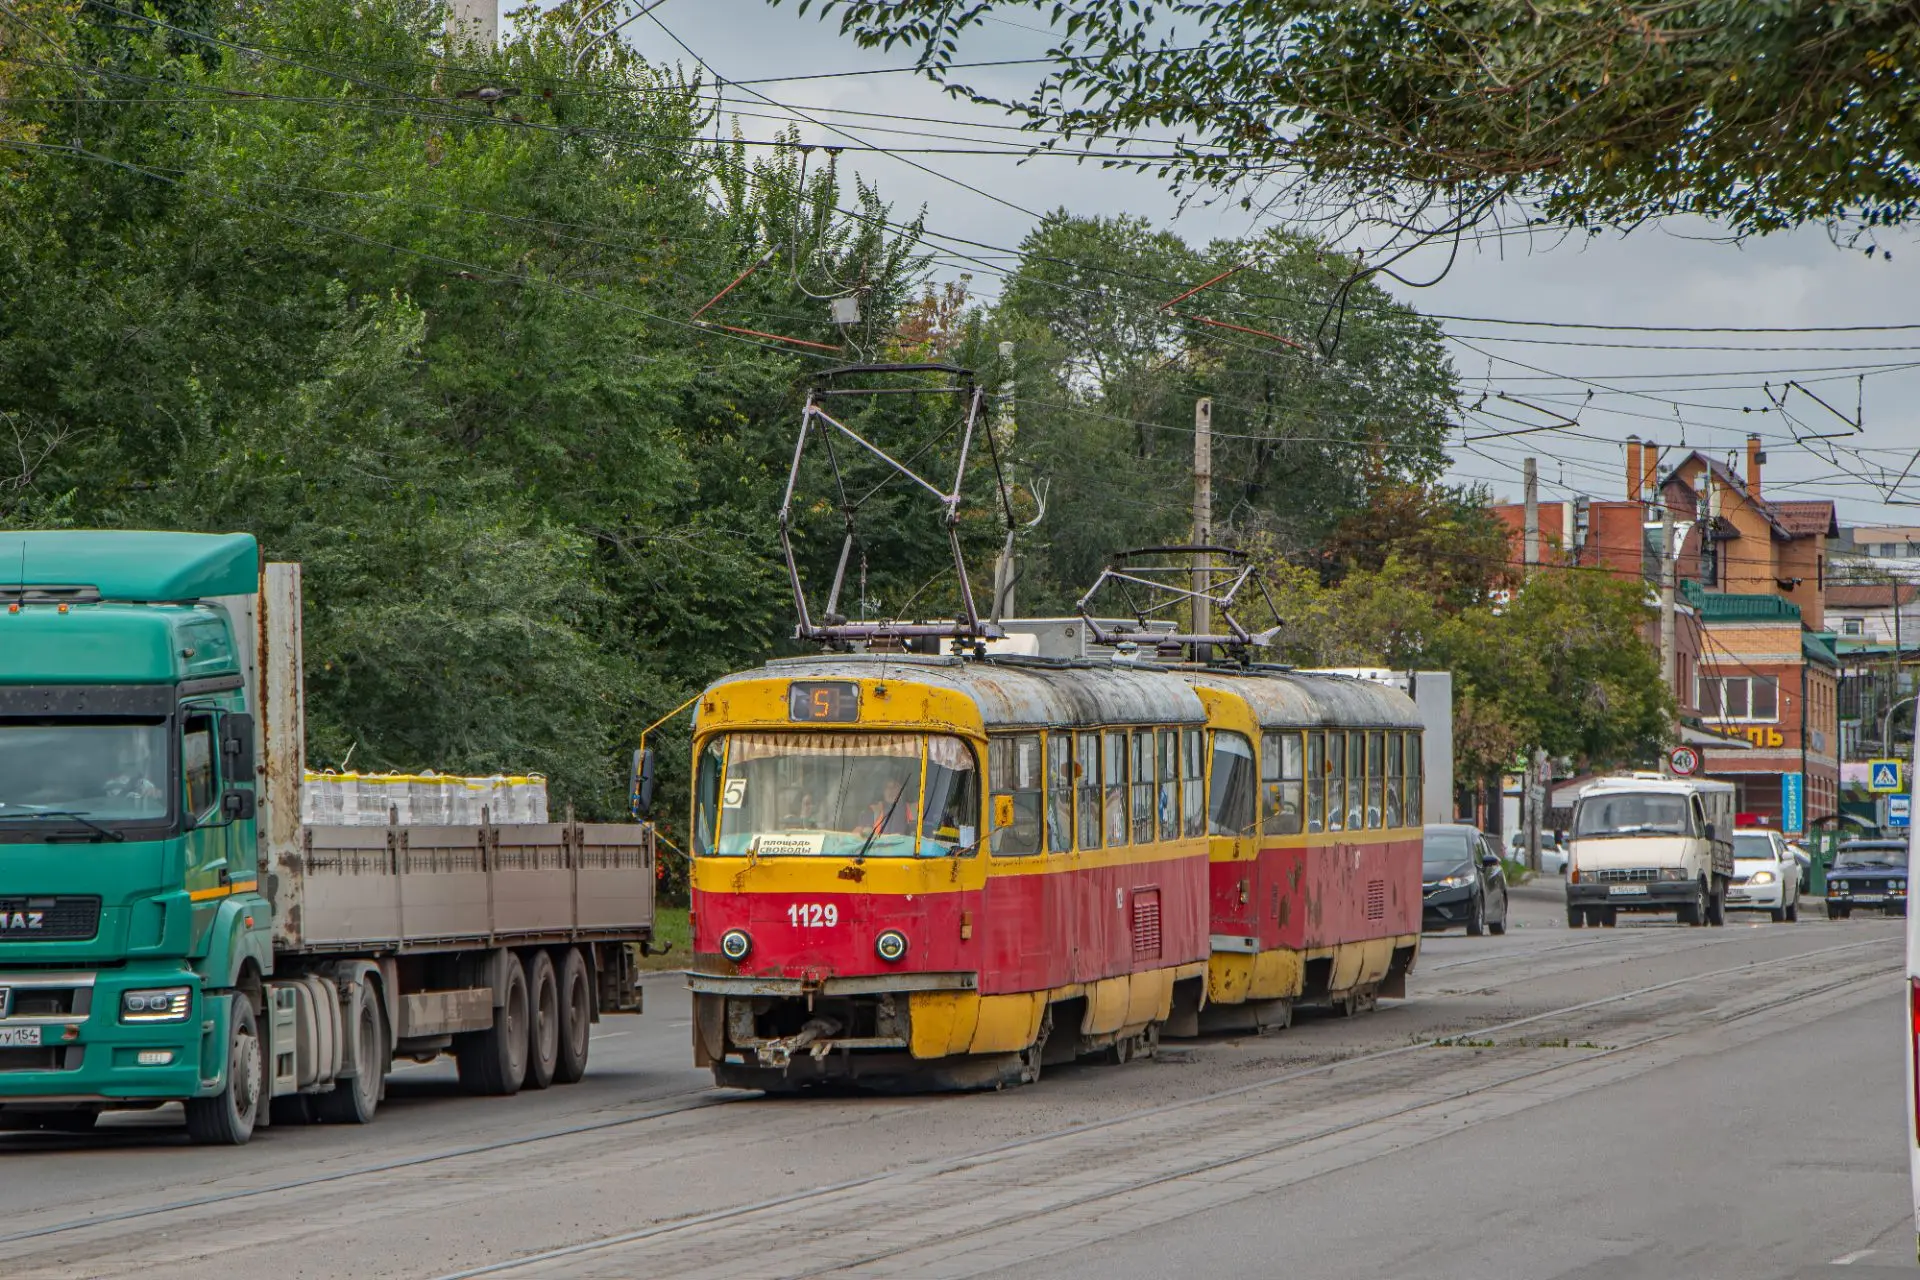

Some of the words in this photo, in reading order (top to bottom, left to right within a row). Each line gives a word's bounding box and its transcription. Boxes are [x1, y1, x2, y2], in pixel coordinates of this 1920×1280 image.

[815, 689, 829, 717] 5
[1673, 751, 1692, 768] 40
[724, 781, 744, 805] 5
[787, 903, 838, 927] 1129
[15, 1029, 38, 1040] 154
